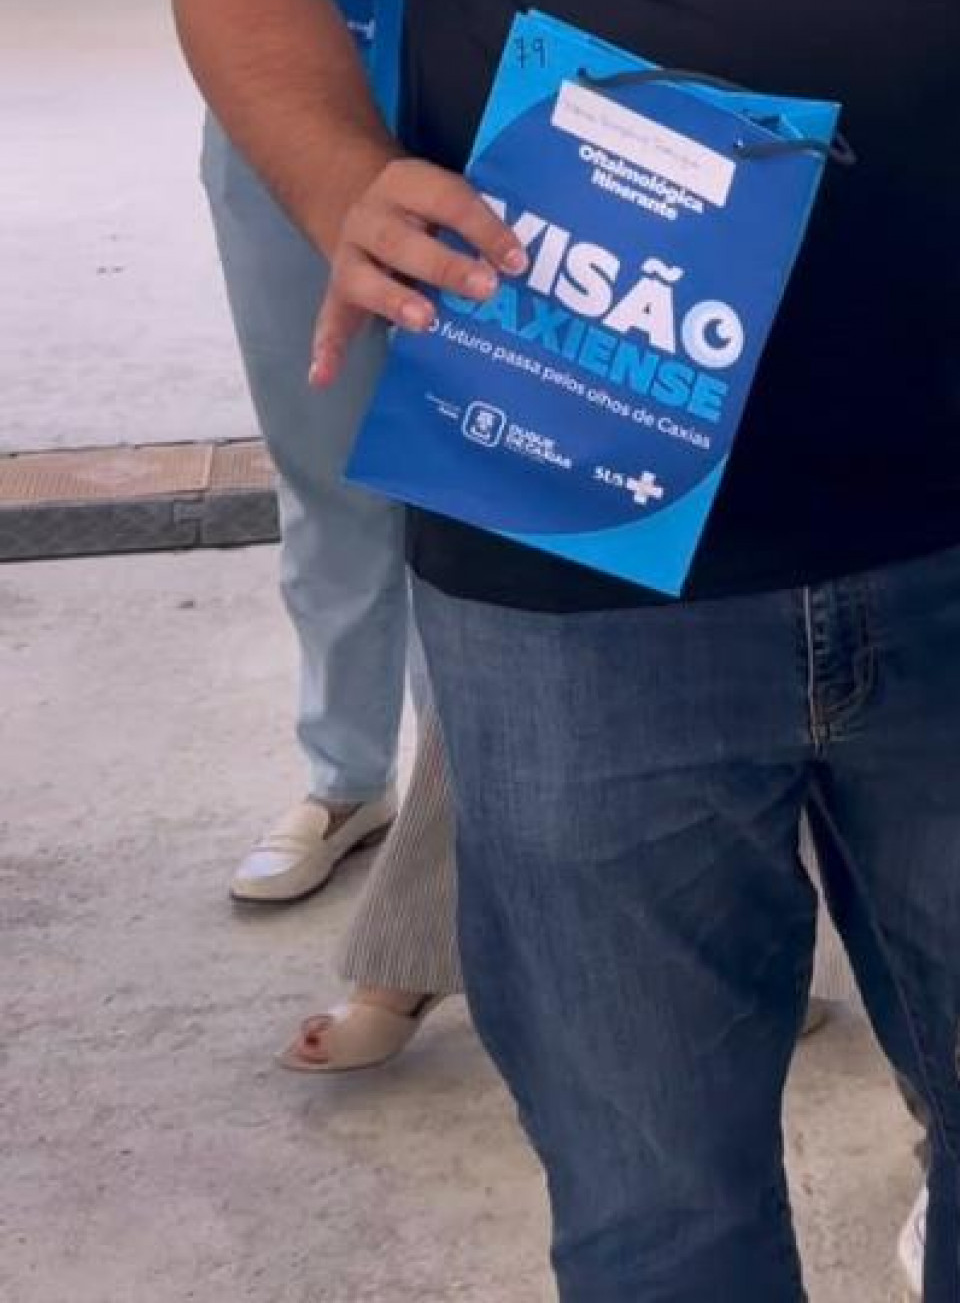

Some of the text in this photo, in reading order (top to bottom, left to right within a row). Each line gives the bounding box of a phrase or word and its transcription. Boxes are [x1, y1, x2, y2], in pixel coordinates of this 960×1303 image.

[441, 320, 493, 354] futuro
[632, 407, 656, 427] de
[657, 417, 711, 450] Caxias
